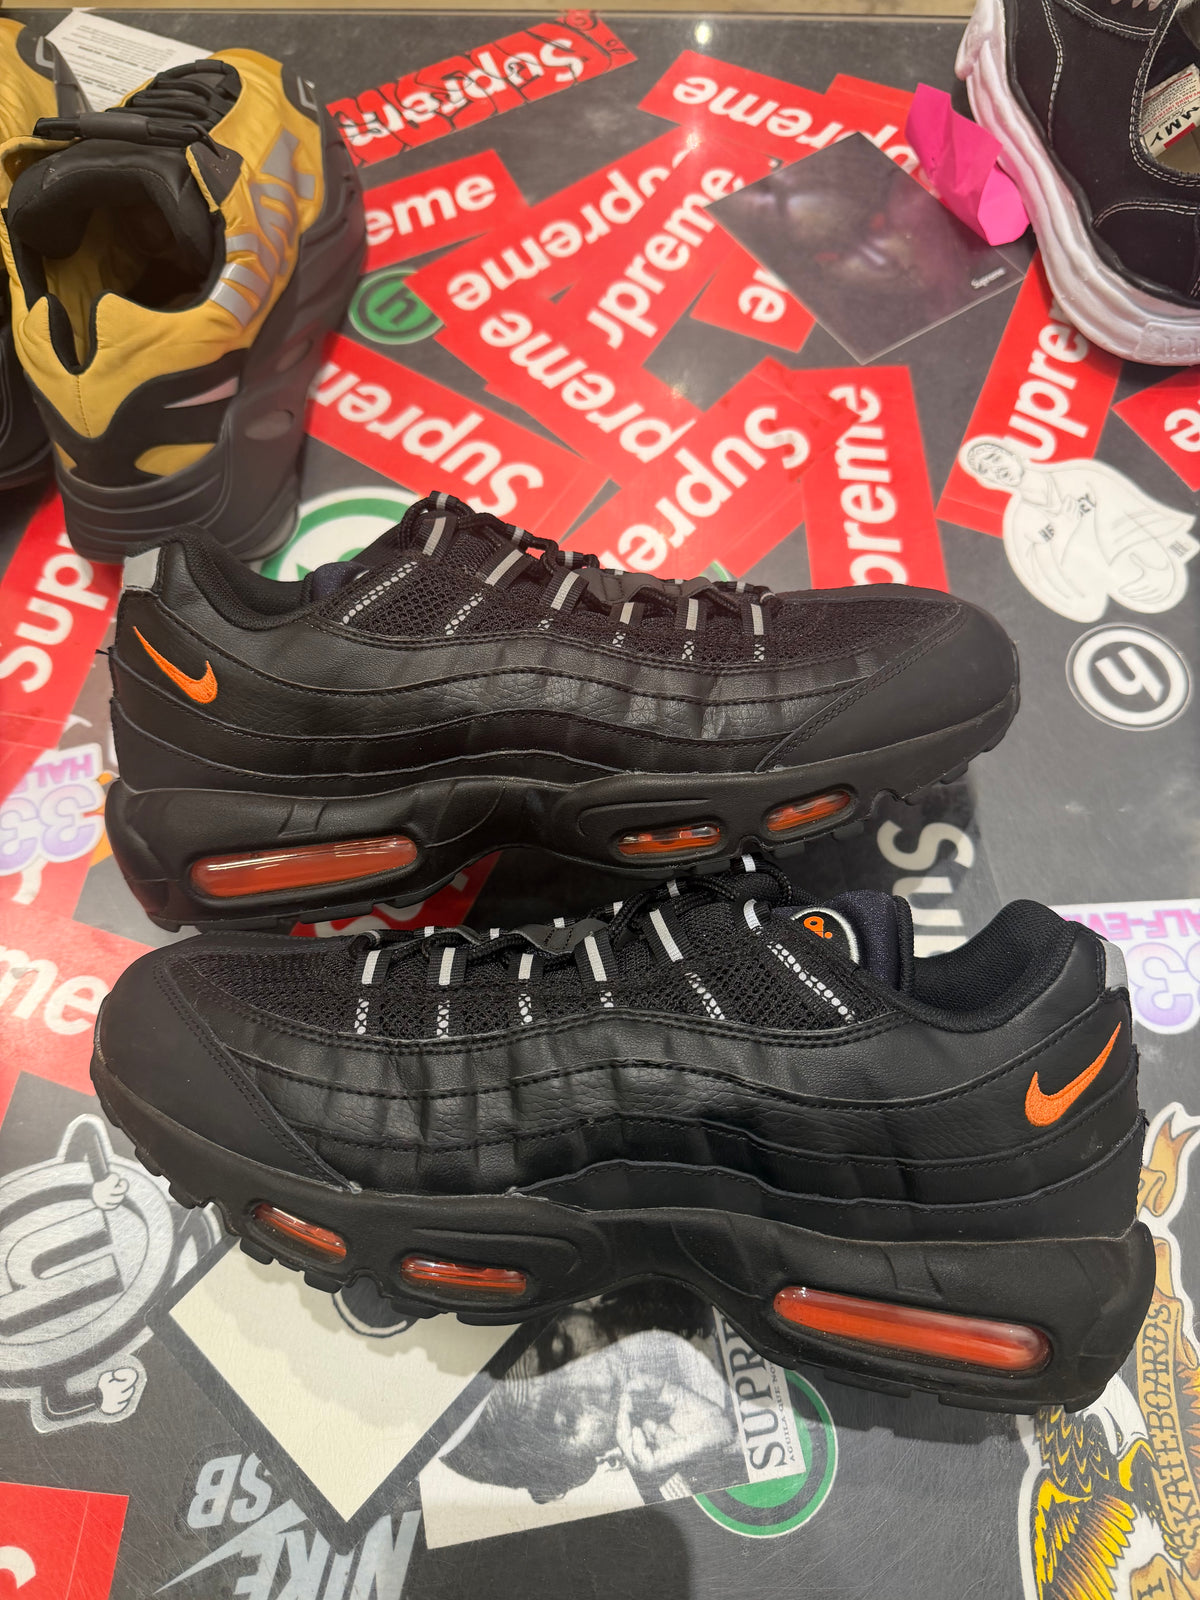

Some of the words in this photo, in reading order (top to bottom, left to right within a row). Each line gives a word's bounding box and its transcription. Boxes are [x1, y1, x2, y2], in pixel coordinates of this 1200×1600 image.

[479, 311, 697, 464] preme
[1003, 302, 1091, 462] upre
[600, 405, 811, 573] Supre
[0, 532, 109, 694] Sup
[768, 1361, 778, 1384] NO
[187, 1452, 273, 1529] SB
[233, 1509, 422, 1600] NIKE
